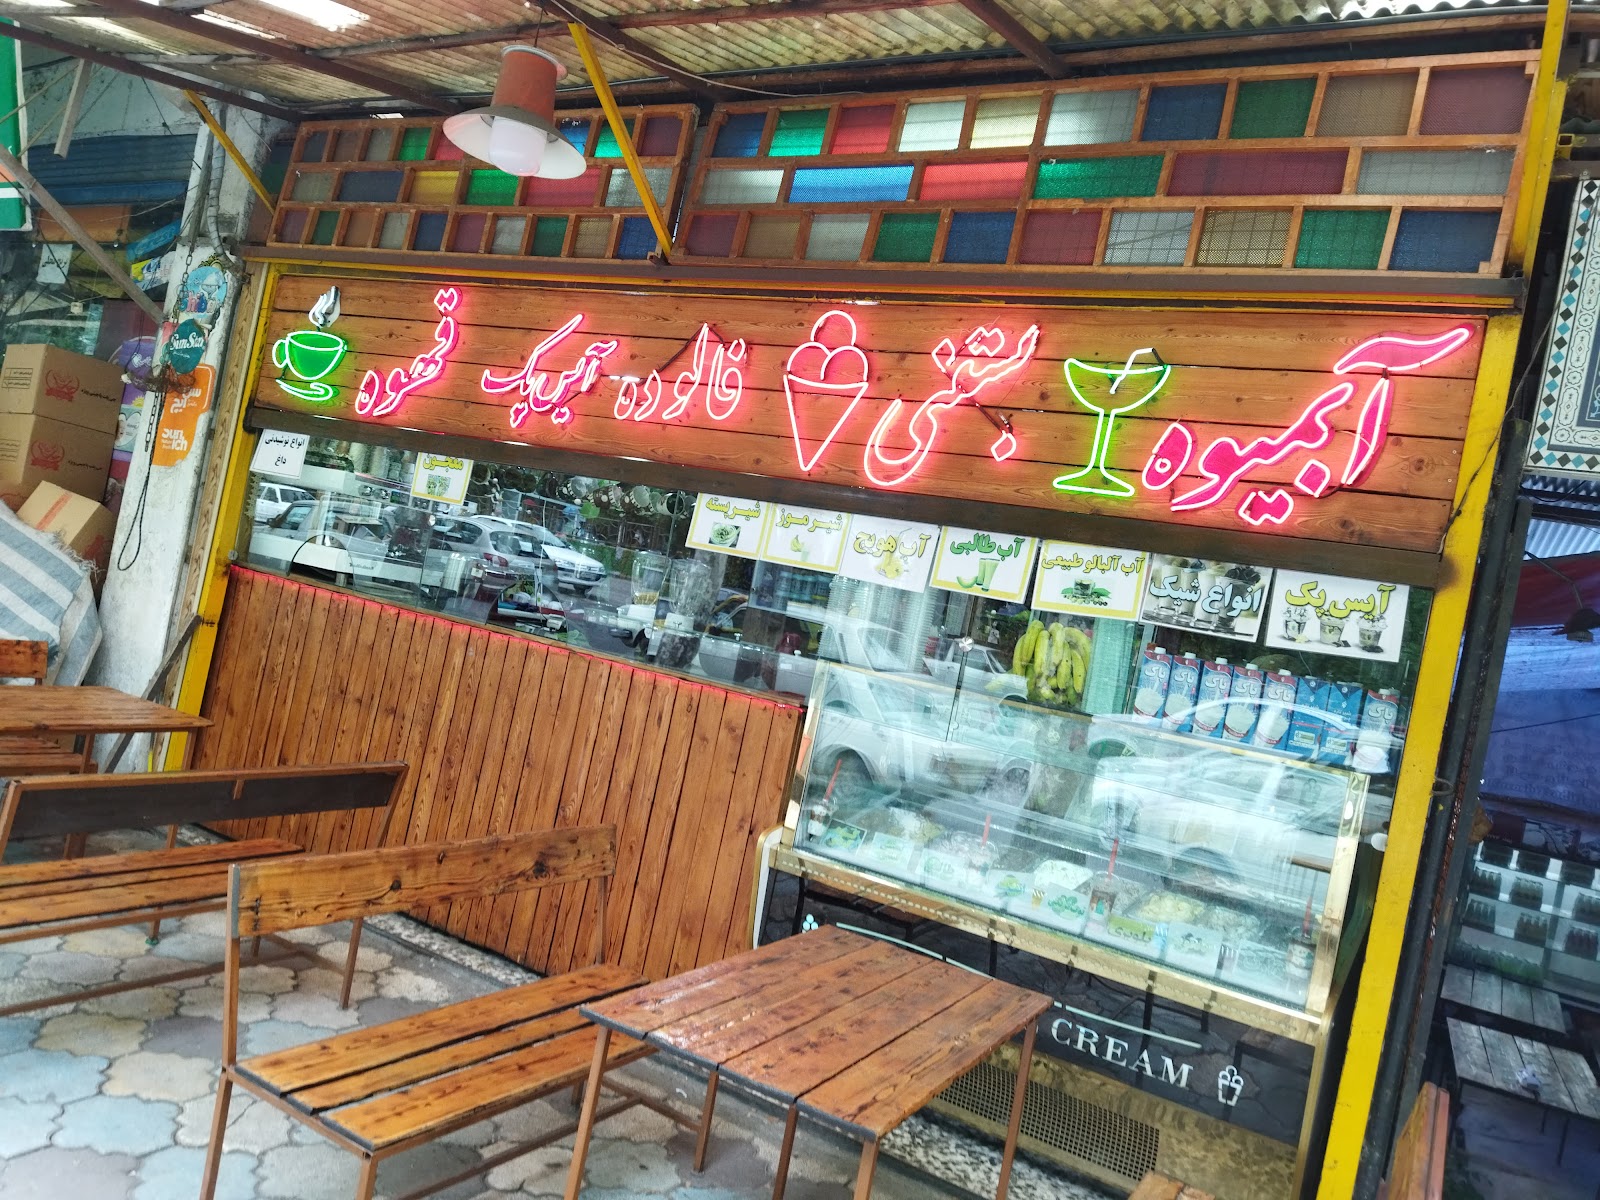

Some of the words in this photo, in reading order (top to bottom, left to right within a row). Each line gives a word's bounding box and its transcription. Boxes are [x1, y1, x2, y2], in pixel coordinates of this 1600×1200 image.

[355, 287, 464, 417] قهوه
[613, 322, 748, 421] فالوده
[863, 323, 1040, 486] بستنی
[1141, 325, 1474, 526] آبمیوه
[265, 433, 290, 447] نوشیدنی
[290, 437, 306, 449] انواع
[274, 454, 287, 467] داغ
[423, 453, 464, 473] معجون
[775, 507, 810, 529] موز
[807, 514, 843, 534] شیر
[853, 531, 898, 558] هویج
[899, 532, 931, 562] آب
[950, 532, 997, 556] طالبی
[996, 536, 1026, 562] آب
[1041, 552, 1084, 571] طبیعی
[1082, 554, 1123, 575] آلبالو
[1120, 557, 1146, 577] آب
[1149, 575, 1201, 607] شیک
[1201, 583, 1263, 617] انواع
[1285, 580, 1328, 616] پک
[1328, 584, 1397, 620] آیس
[1144, 665, 1166, 683] پاک
[1174, 670, 1195, 687] پاک
[1205, 676, 1228, 694] پاک
[1235, 681, 1258, 699] پاک
[1268, 687, 1292, 703] پاک
[1368, 703, 1394, 725] پاک
[1051, 1018, 1194, 1088] CREAM
